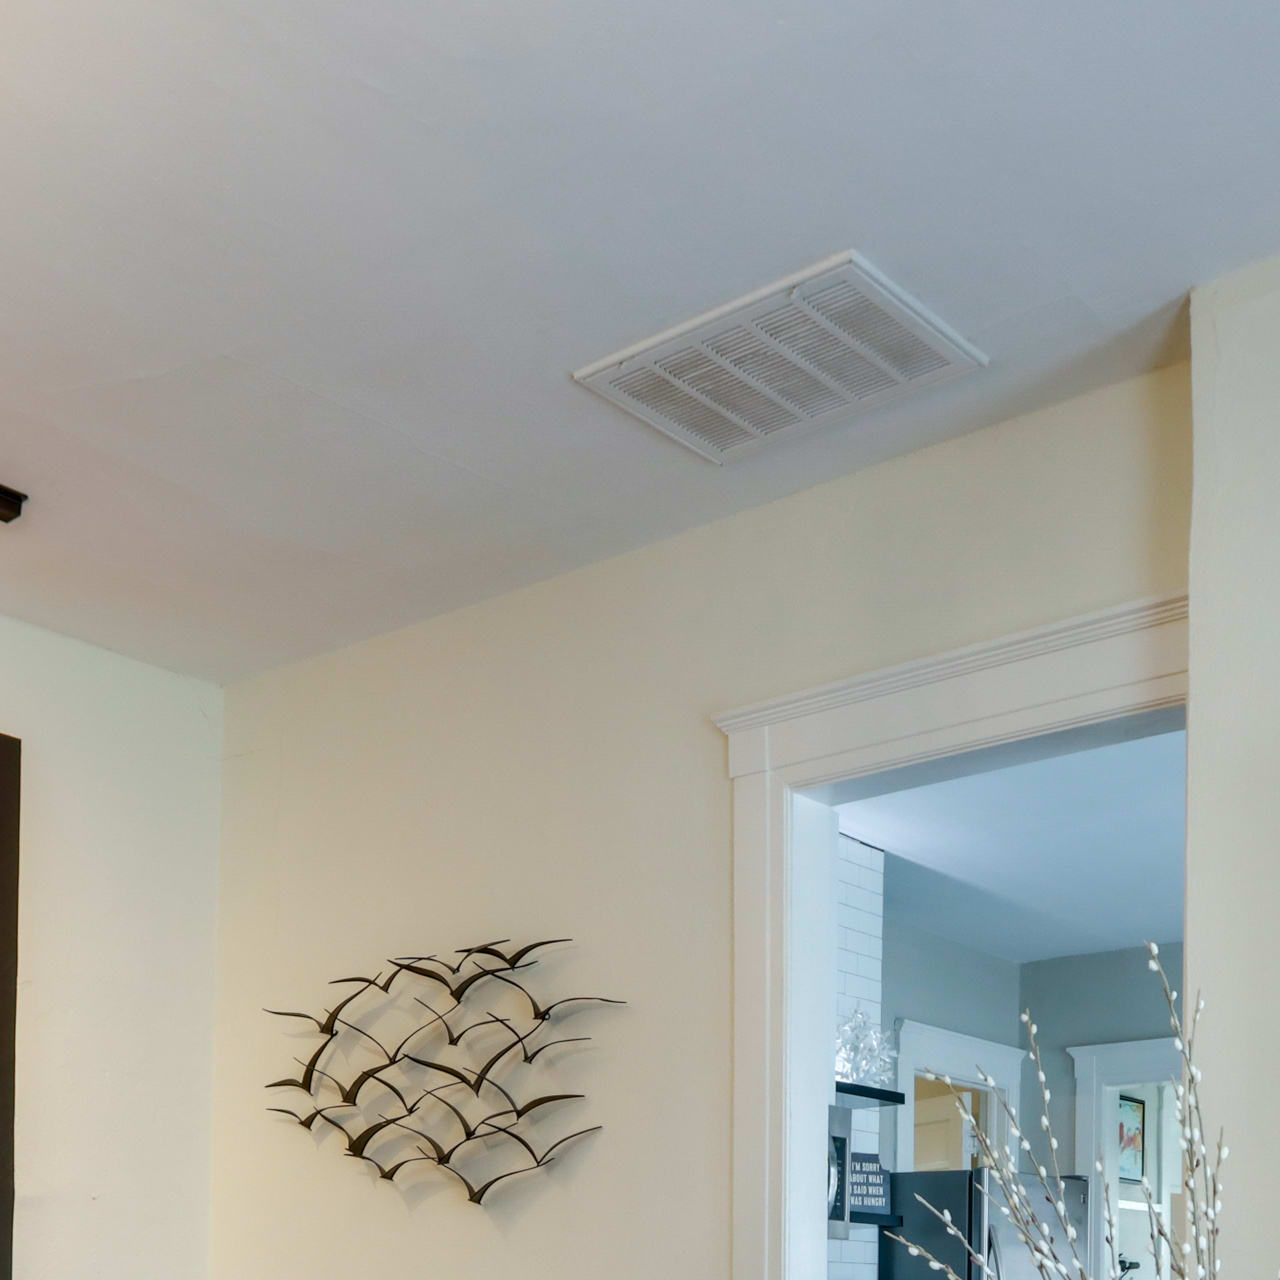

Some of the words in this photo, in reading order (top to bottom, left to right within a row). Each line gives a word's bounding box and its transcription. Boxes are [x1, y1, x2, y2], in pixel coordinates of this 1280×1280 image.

[862, 1162, 881, 1172] SORRY
[868, 1174, 884, 1184] WHAT
[853, 1185, 867, 1194] SAID
[868, 1186, 884, 1195] WHEN
[863, 1197, 886, 1207] HUNGRY
